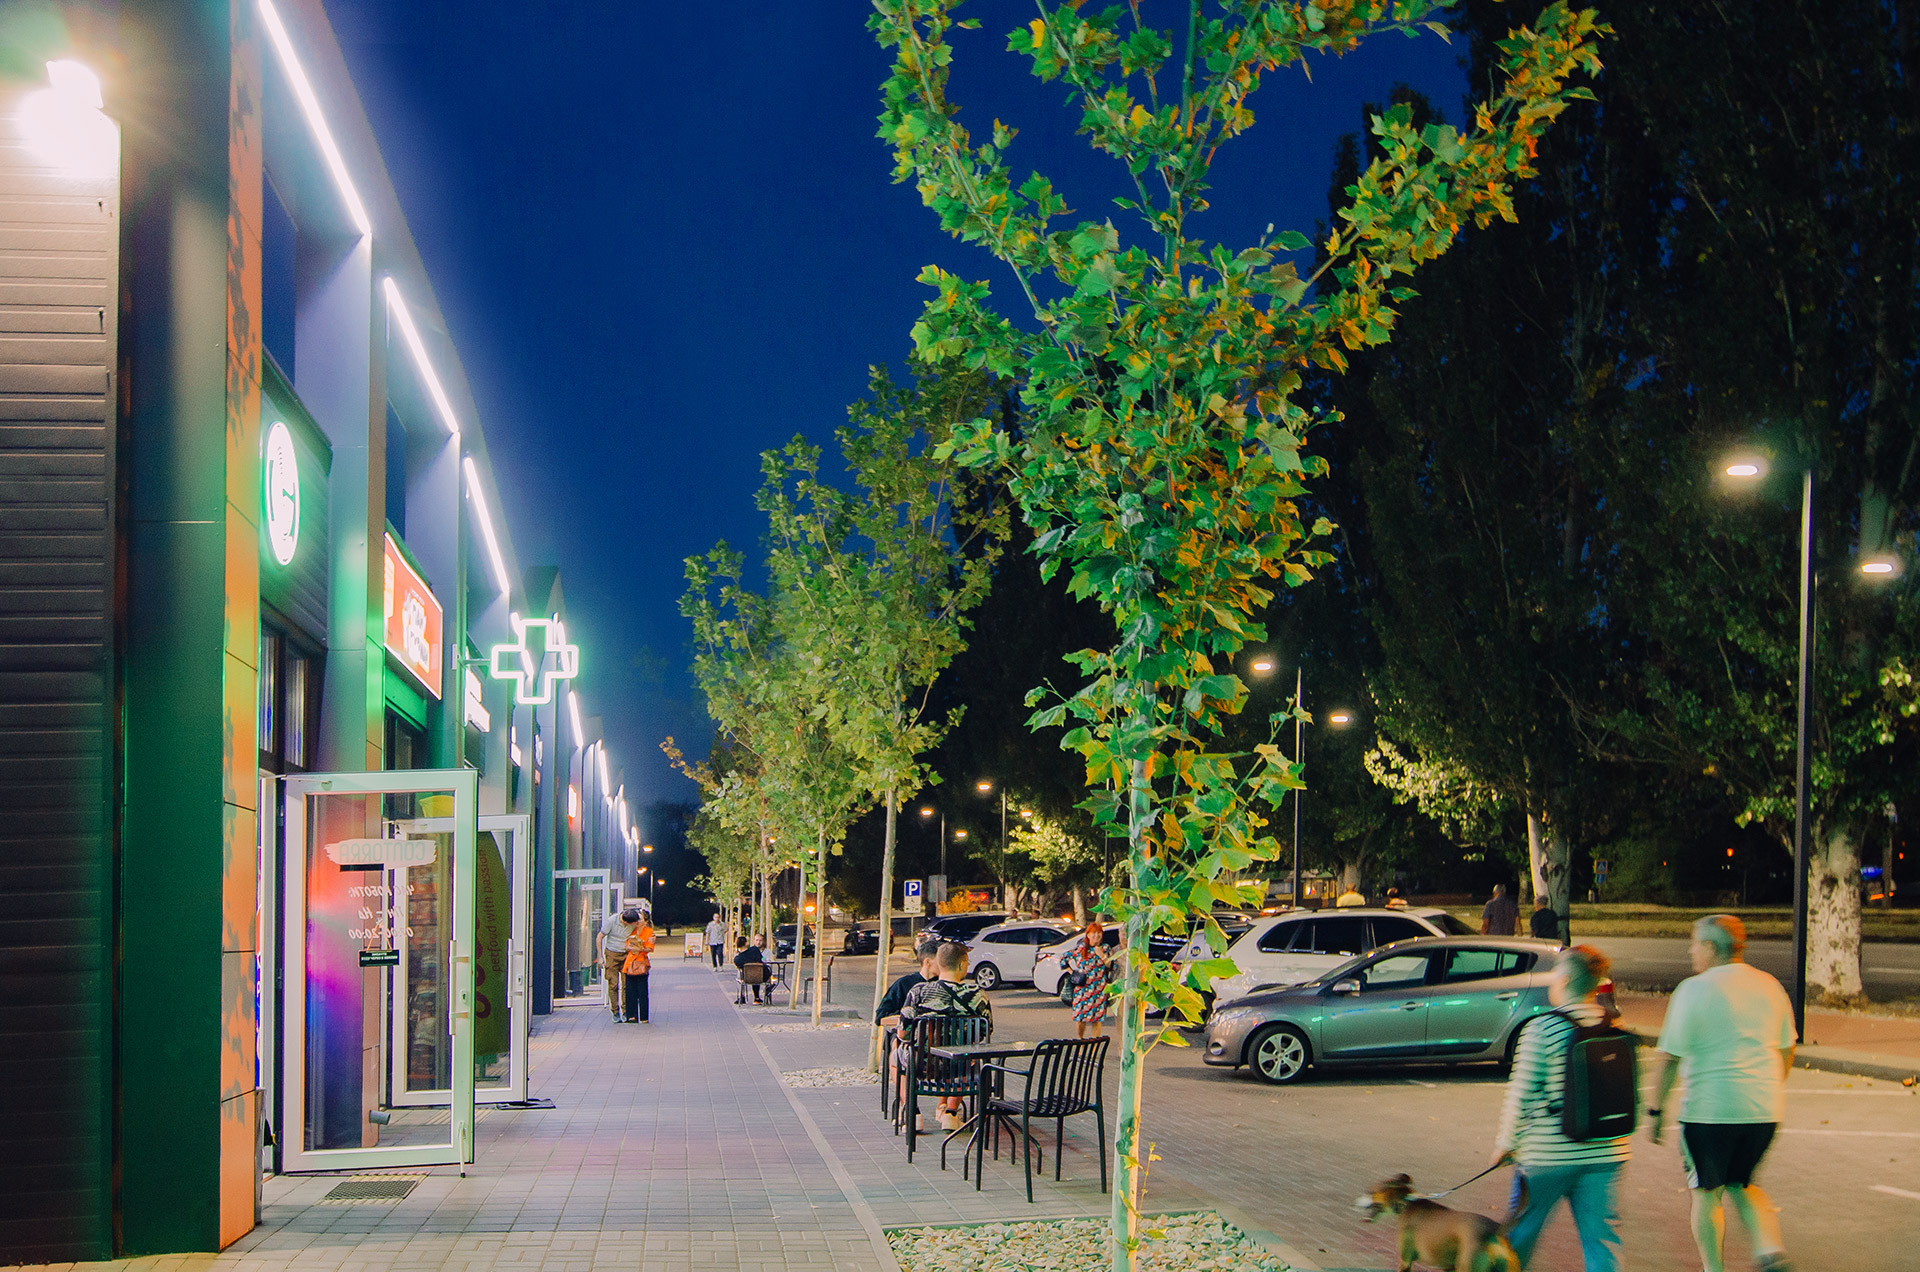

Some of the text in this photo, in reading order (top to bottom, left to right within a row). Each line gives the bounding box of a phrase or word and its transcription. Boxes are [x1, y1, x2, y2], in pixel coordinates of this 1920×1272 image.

[478, 849, 493, 894] passion
[909, 882, 918, 896] P
[482, 896, 496, 923] with
[488, 926, 503, 973] petfood
